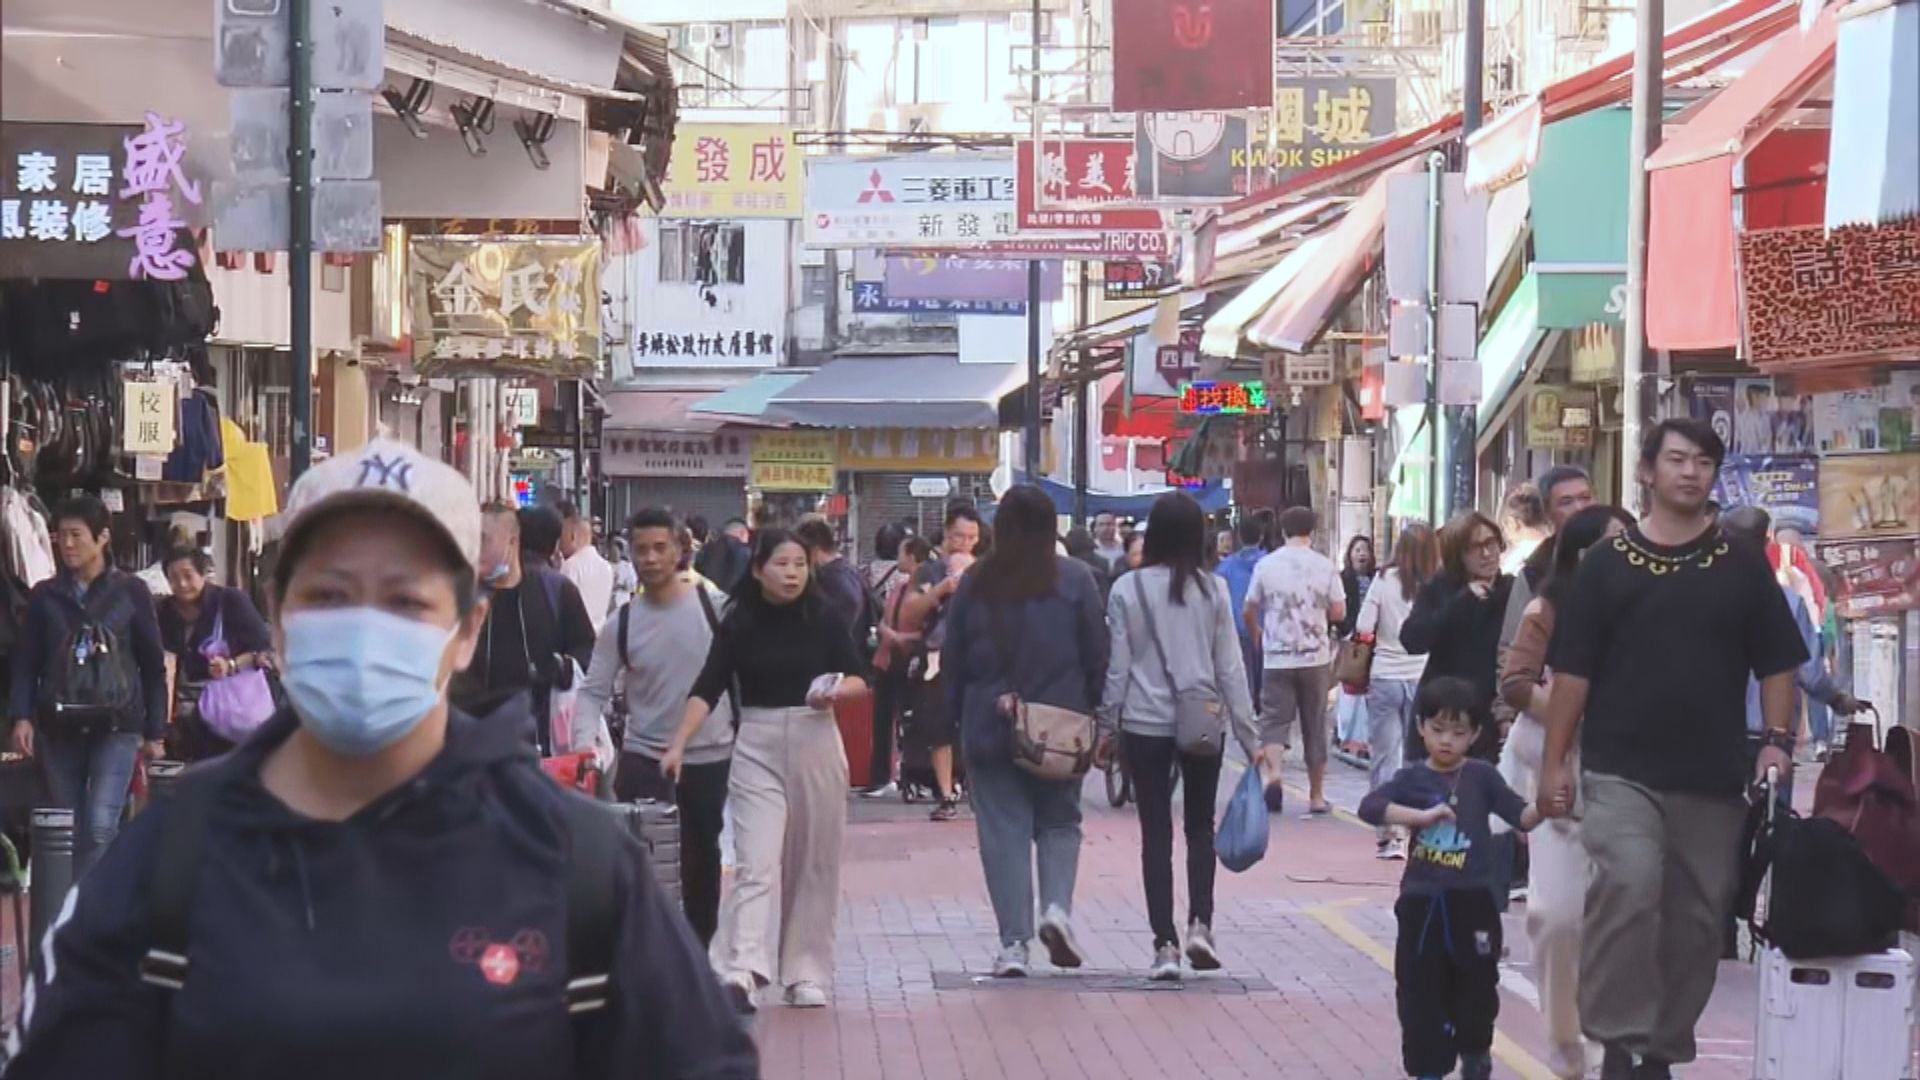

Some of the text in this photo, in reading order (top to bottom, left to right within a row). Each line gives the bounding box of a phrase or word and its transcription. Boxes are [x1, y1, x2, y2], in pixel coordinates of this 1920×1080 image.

[1231, 148, 1303, 167] KWOK
[17, 152, 113, 195] 家居
[1138, 233, 1165, 251] CO.
